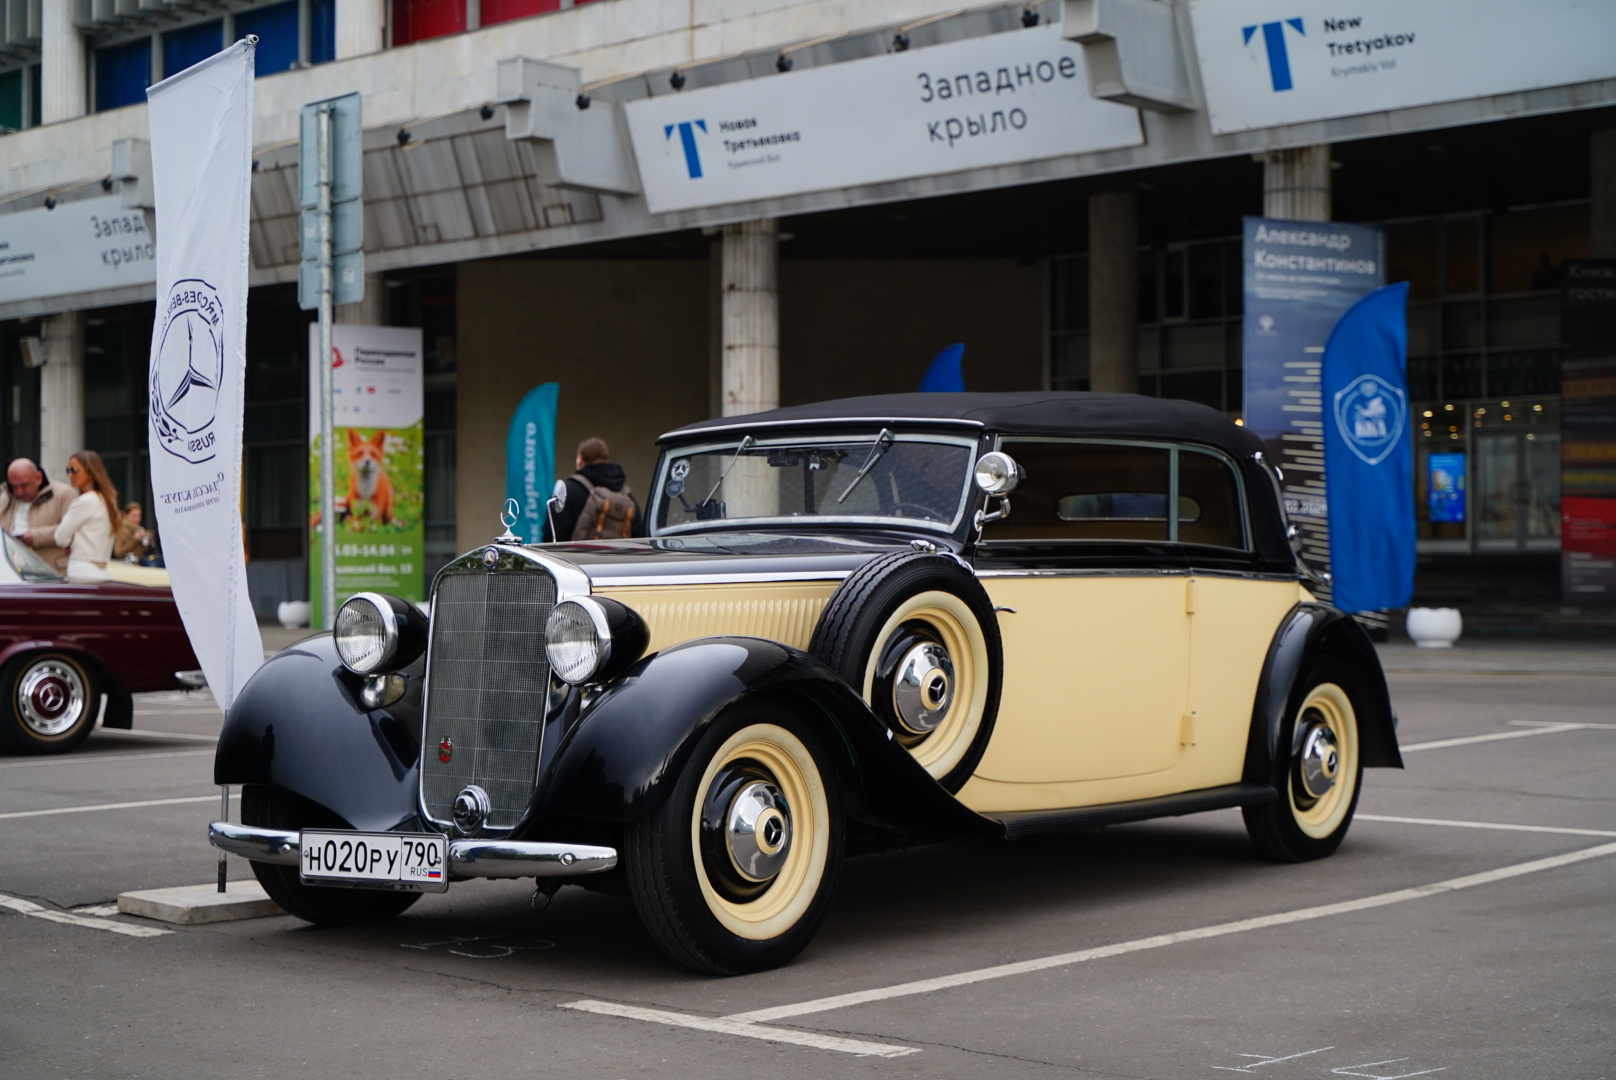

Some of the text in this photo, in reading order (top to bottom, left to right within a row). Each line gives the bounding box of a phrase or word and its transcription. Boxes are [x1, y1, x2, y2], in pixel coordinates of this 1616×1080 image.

[1323, 15, 1362, 33] New
[1327, 32, 1416, 56] Tretyakov
[917, 56, 1076, 103] Западное
[719, 117, 758, 132] Новая
[927, 107, 1028, 147] крыло
[723, 131, 801, 154] Третьяковка
[91, 214, 145, 238] Запад
[1255, 224, 1351, 252] Александр
[100, 243, 156, 270] крыло
[1254, 249, 1376, 274] Константинов
[525, 422, 539, 519] Горького
[403, 841, 438, 868] 790
[410, 867, 428, 877] RUS
